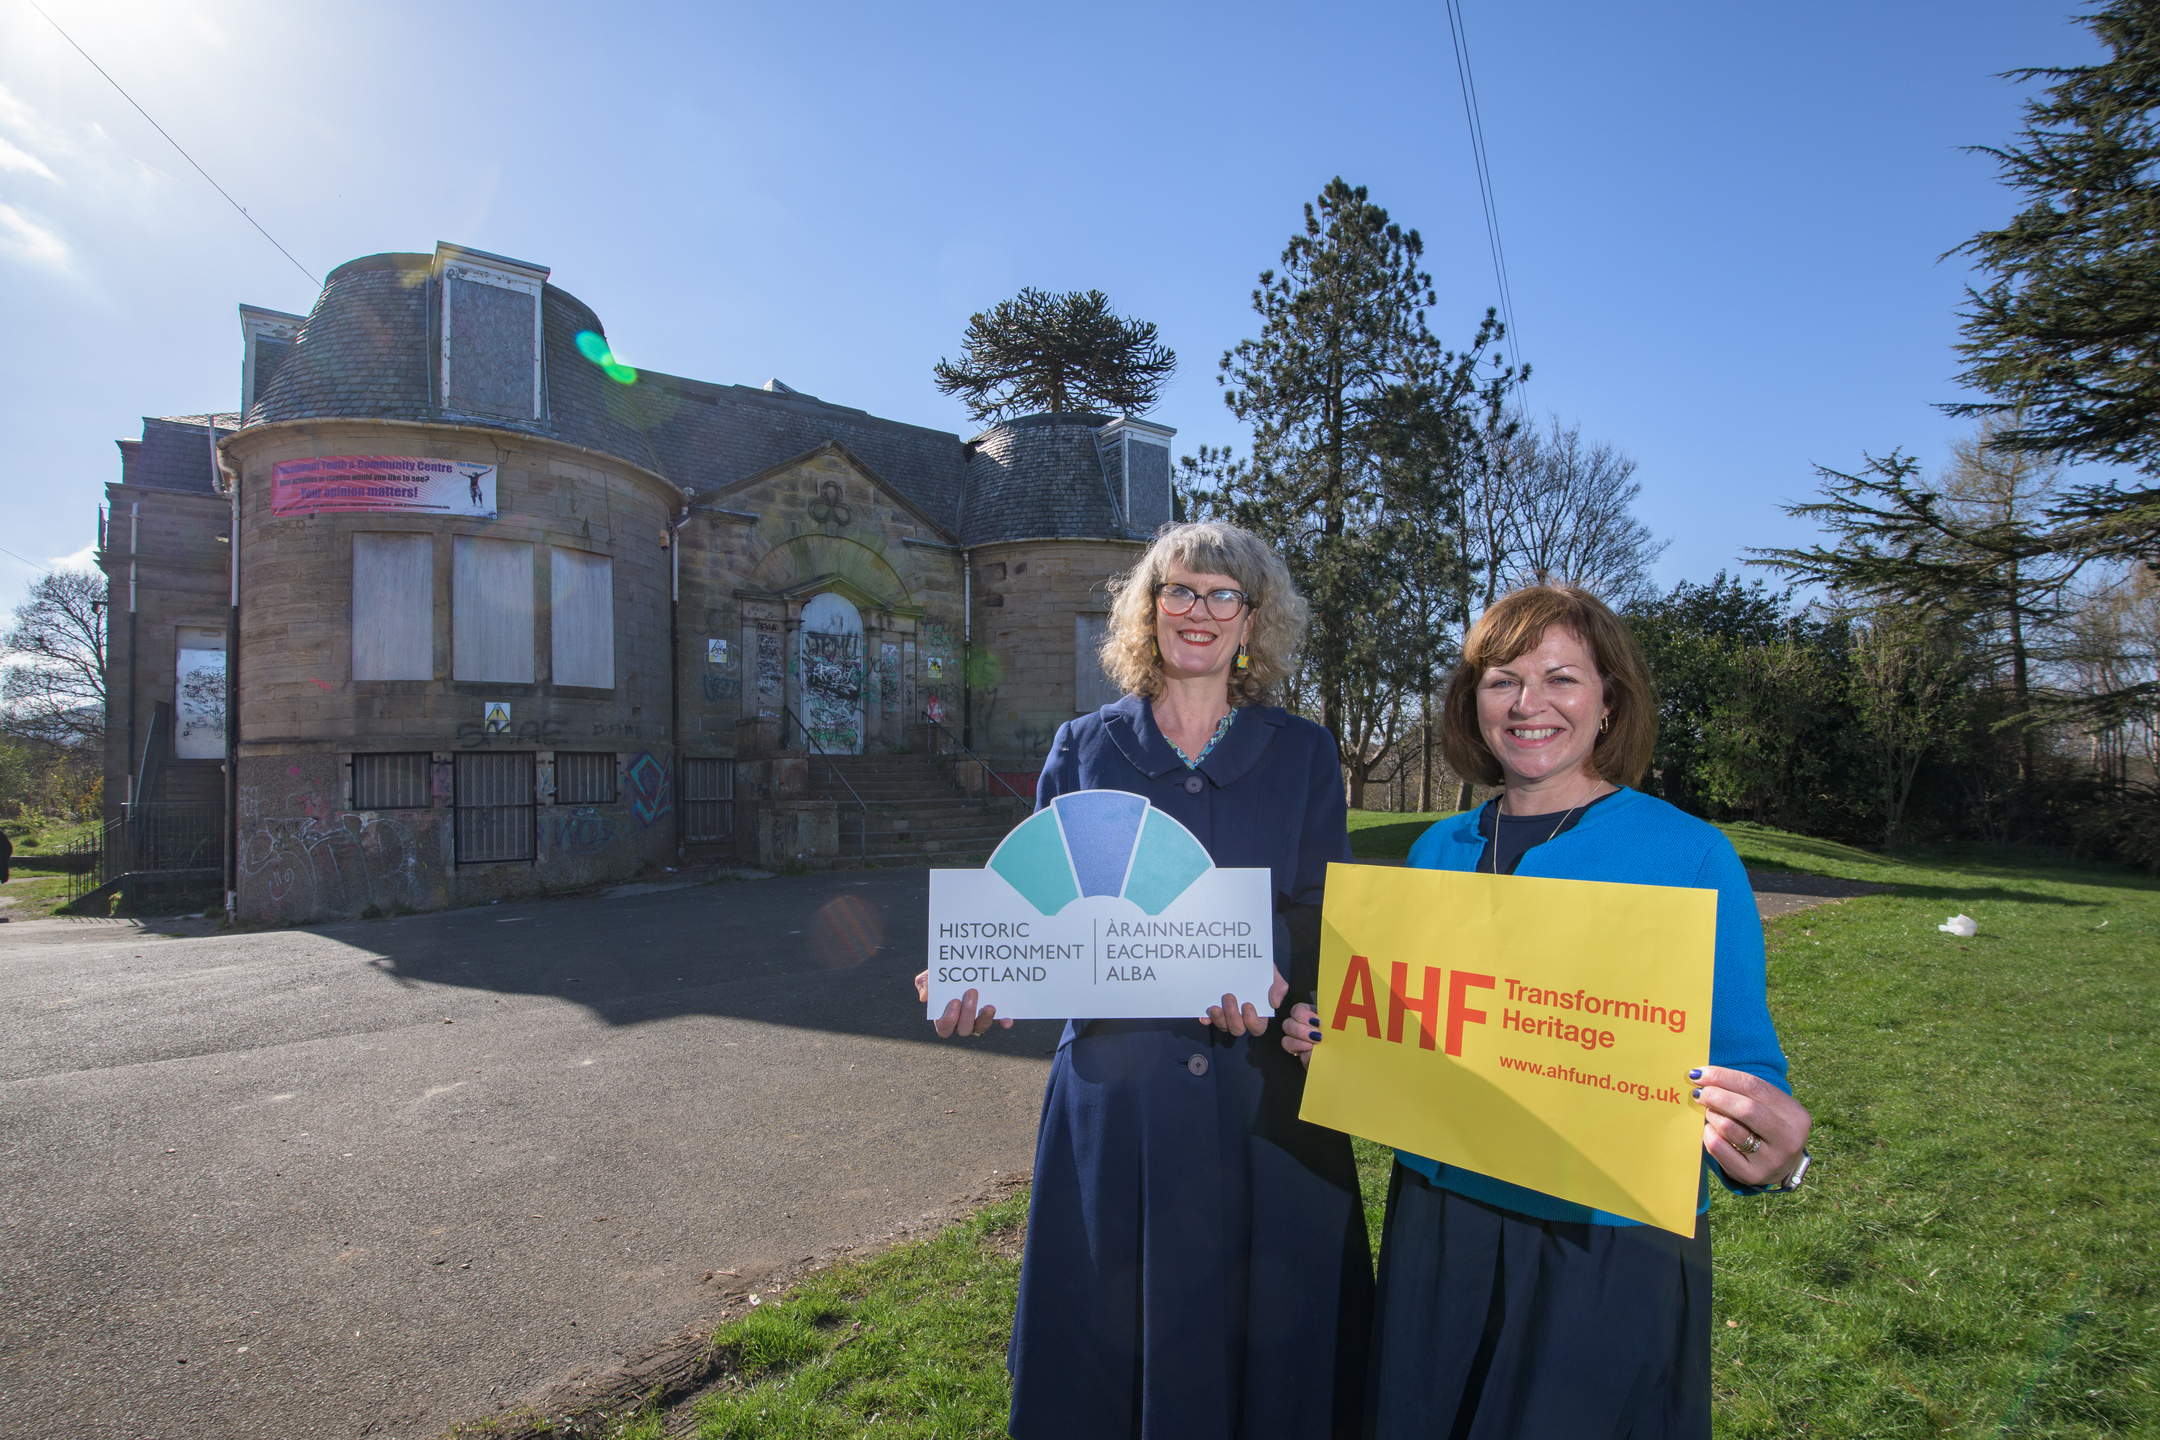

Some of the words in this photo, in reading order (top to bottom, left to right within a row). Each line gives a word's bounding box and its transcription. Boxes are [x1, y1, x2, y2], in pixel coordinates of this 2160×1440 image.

[321, 459, 347, 470] Youth
[349, 460, 355, 469] &
[357, 459, 415, 471] Community
[417, 461, 453, 473] Centre
[291, 476, 317, 485] activities
[326, 474, 350, 482] classes
[351, 473, 372, 481] would
[301, 487, 322, 499] Your
[324, 485, 365, 498] opinion
[367, 486, 418, 498] matters!
[939, 922, 1030, 939] HISTORIC
[1105, 918, 1251, 938] ÀRAINNEACHD
[939, 944, 1084, 960] ENVIRONMENT
[1106, 943, 1263, 960] EACHDRAIDHEIL
[938, 966, 1047, 982] SCOTLAND
[1105, 965, 1157, 981] ALBA
[1331, 955, 1496, 1058] AHF
[1504, 977, 1686, 1033] Transforming
[1502, 1008, 1616, 1051] Heritage
[1499, 1055, 1681, 1105] www.ahfund.org.uk
